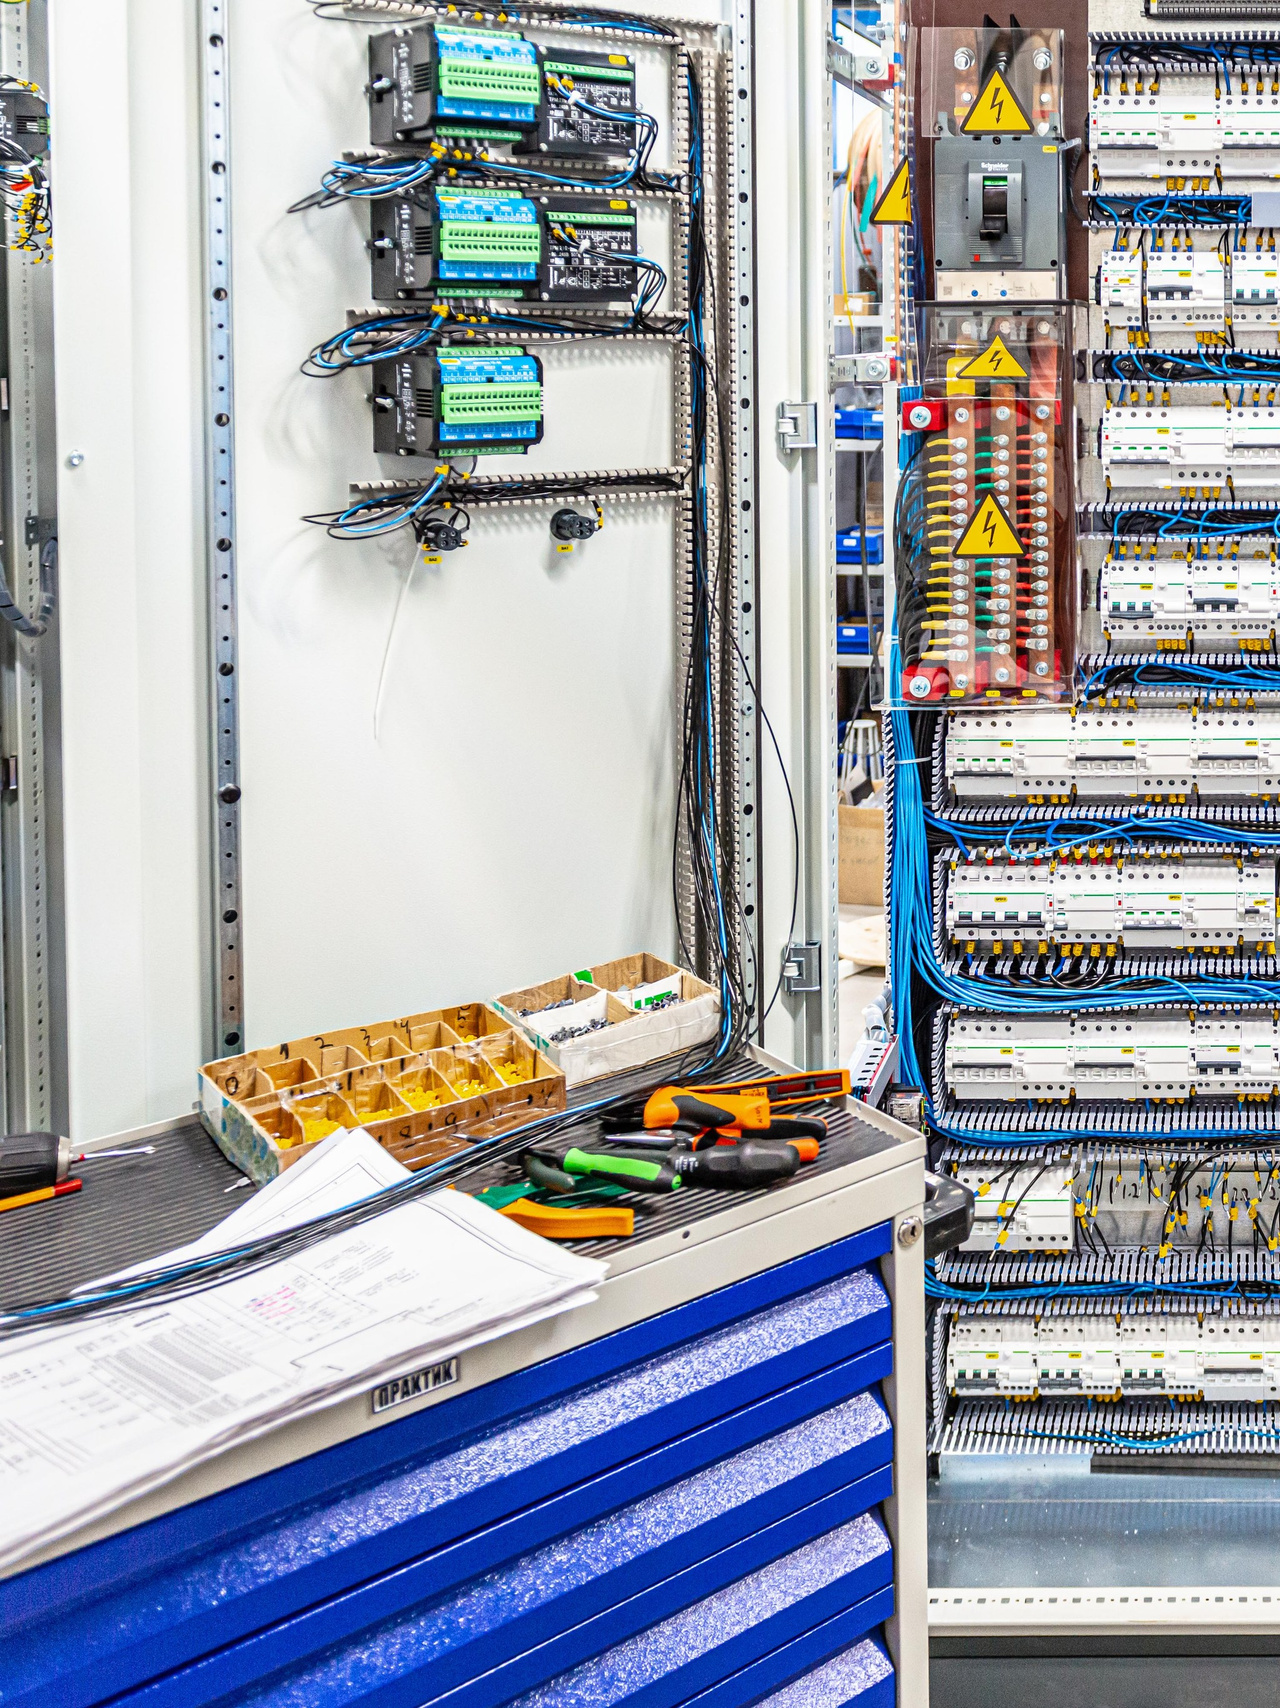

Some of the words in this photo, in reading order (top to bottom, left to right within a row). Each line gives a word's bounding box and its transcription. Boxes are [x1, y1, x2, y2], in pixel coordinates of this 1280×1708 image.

[981, 162, 1009, 172] Schneider
[314, 1037, 334, 1049] 2
[1122, 1183, 1140, 1199] 1.2
[378, 1361, 452, 1407] ПРАКТИК
